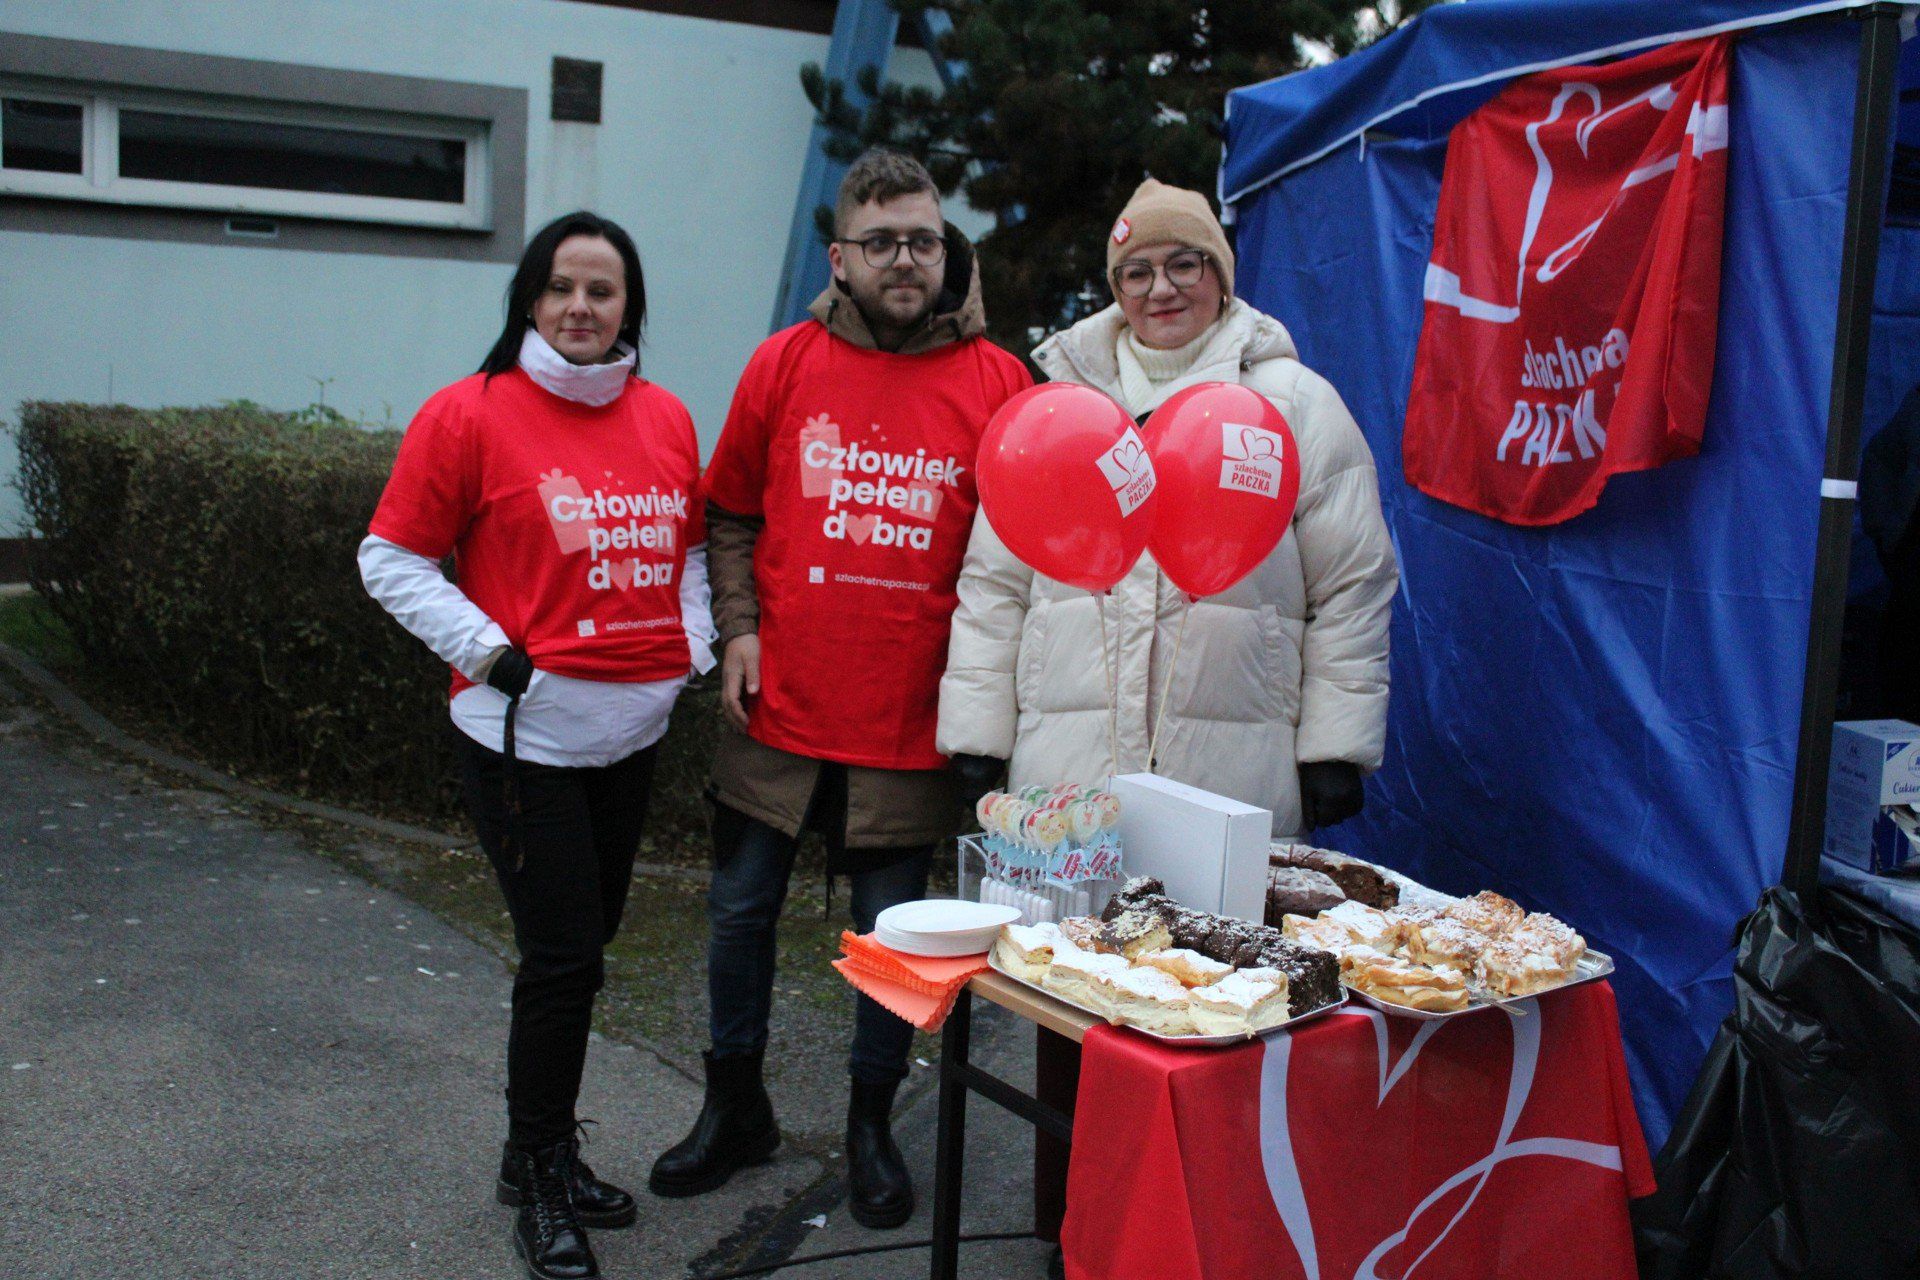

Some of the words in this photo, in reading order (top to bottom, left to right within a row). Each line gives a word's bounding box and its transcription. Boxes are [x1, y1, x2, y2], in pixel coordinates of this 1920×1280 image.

[805, 440, 964, 486] Człowiek
[828, 477, 933, 513] pełen
[1128, 477, 1153, 507] PACZKA
[1231, 473, 1269, 492] PACZKA
[552, 486, 687, 522] Człowiek
[589, 519, 672, 561] pełen
